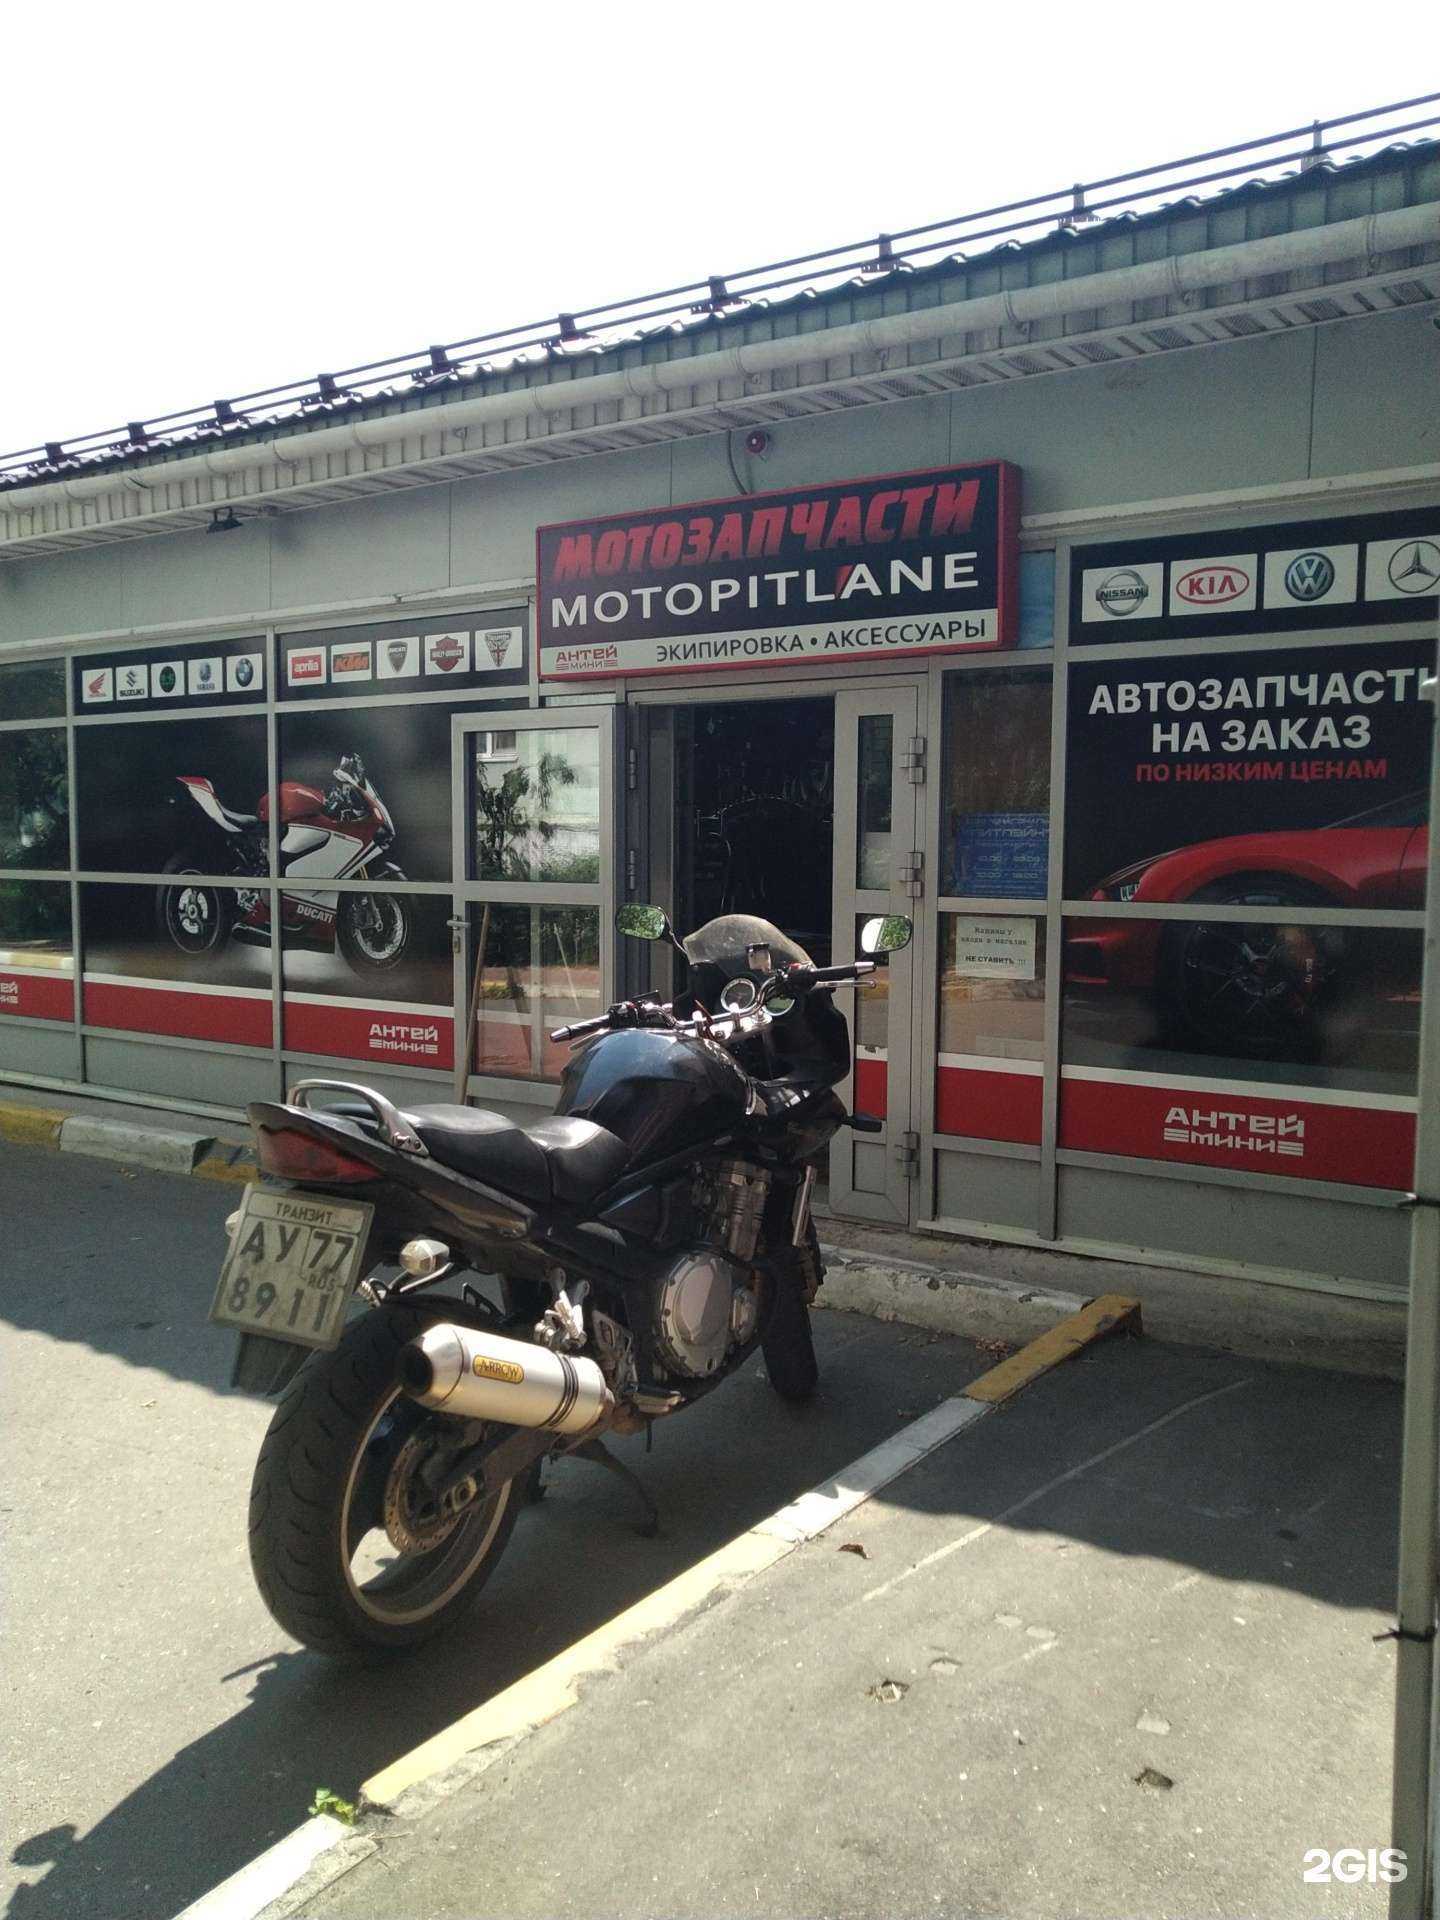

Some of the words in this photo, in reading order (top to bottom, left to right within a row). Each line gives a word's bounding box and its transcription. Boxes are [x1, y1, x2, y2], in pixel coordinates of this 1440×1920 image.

[553, 479, 980, 584] МОТОЗАПЧАСТИ
[552, 551, 979, 628] MOTOPITLANE
[1100, 586, 1146, 600] NISSAN
[1188, 573, 1238, 597] KIA
[656, 634, 804, 662] ЭКИПИРОВКА
[824, 618, 986, 649] АКСЕССУАРЫ
[1152, 720, 1211, 753] НА
[1221, 715, 1372, 751] ЗАКАЗ
[1136, 763, 1170, 783] ПО
[1175, 761, 1284, 782] НИЗКИМ
[1290, 759, 1388, 784] ЦЕНАМ
[296, 904, 334, 924] DUCATI
[276, 1202, 334, 1225] ТРАНЗИТ
[308, 1231, 354, 1273] 77
[228, 1277, 331, 1332] 8911
